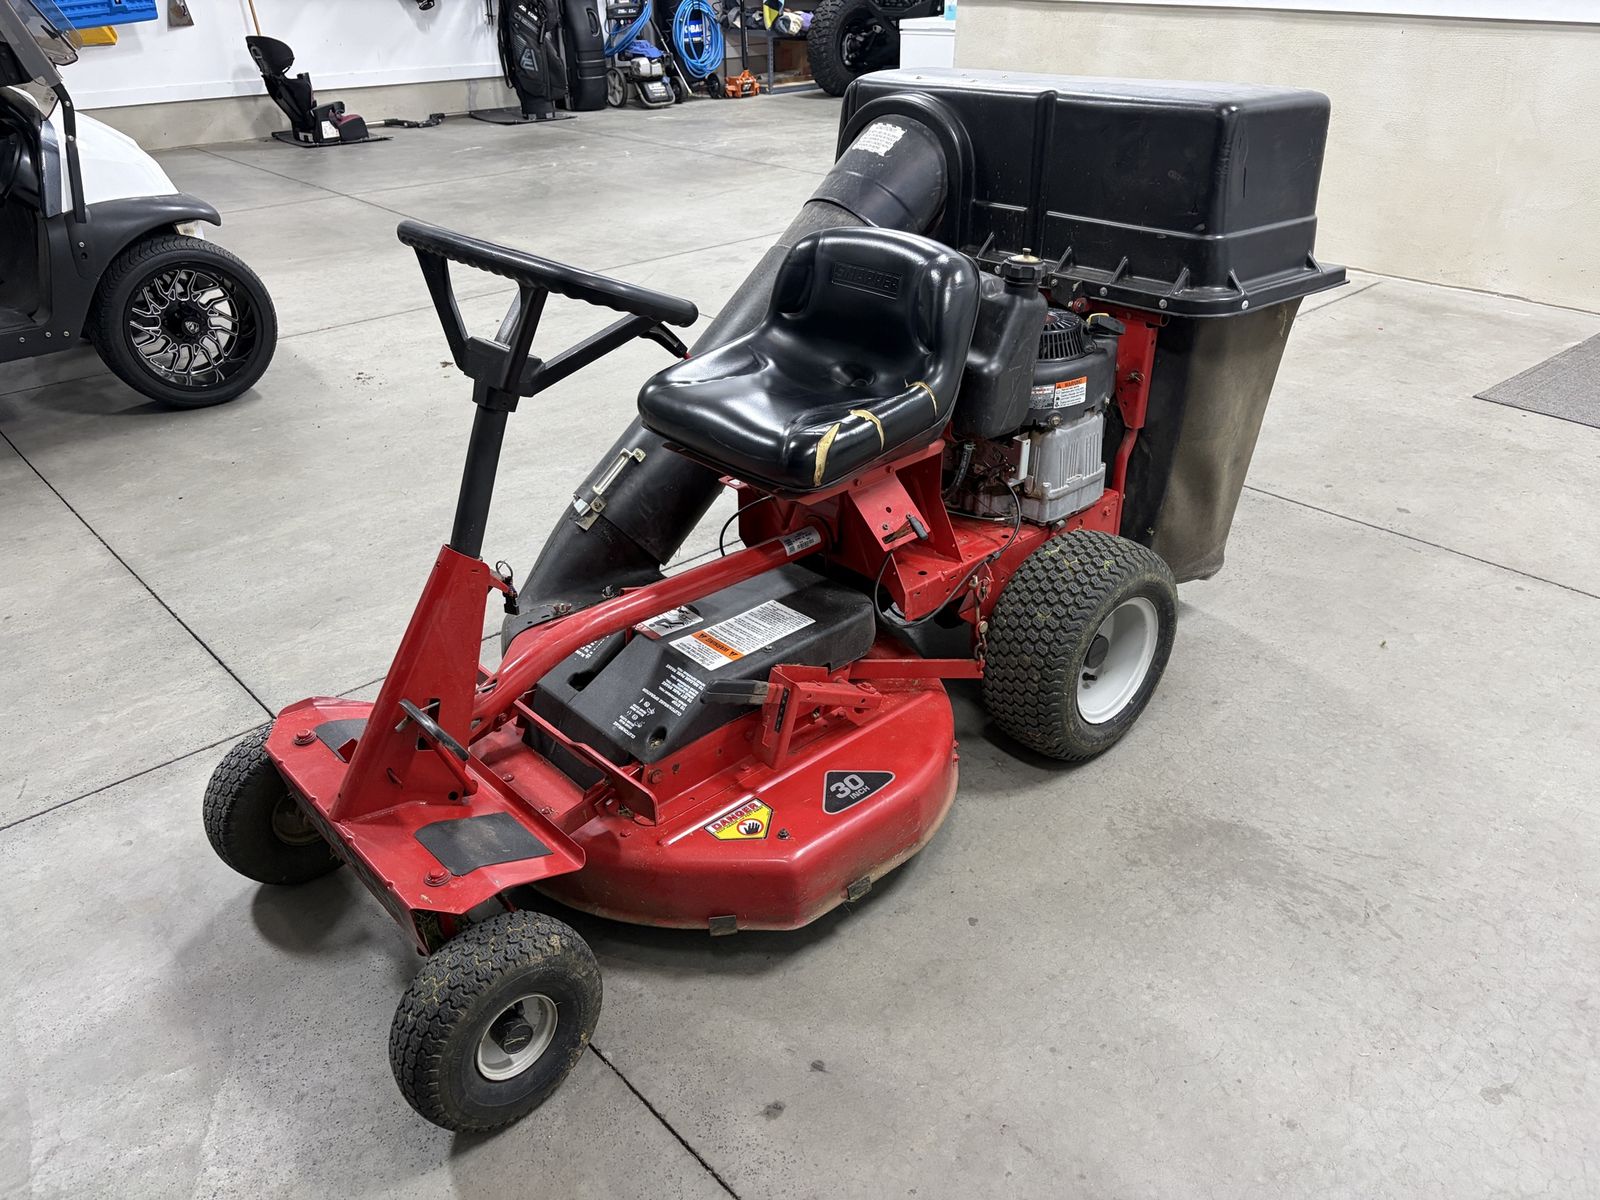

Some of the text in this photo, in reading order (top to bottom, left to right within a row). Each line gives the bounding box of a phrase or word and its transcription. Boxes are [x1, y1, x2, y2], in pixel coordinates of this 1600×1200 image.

[706, 638, 729, 652] WARNING
[830, 774, 865, 799] 30
[849, 786, 870, 800] INCH
[711, 802, 759, 831] DANGER
